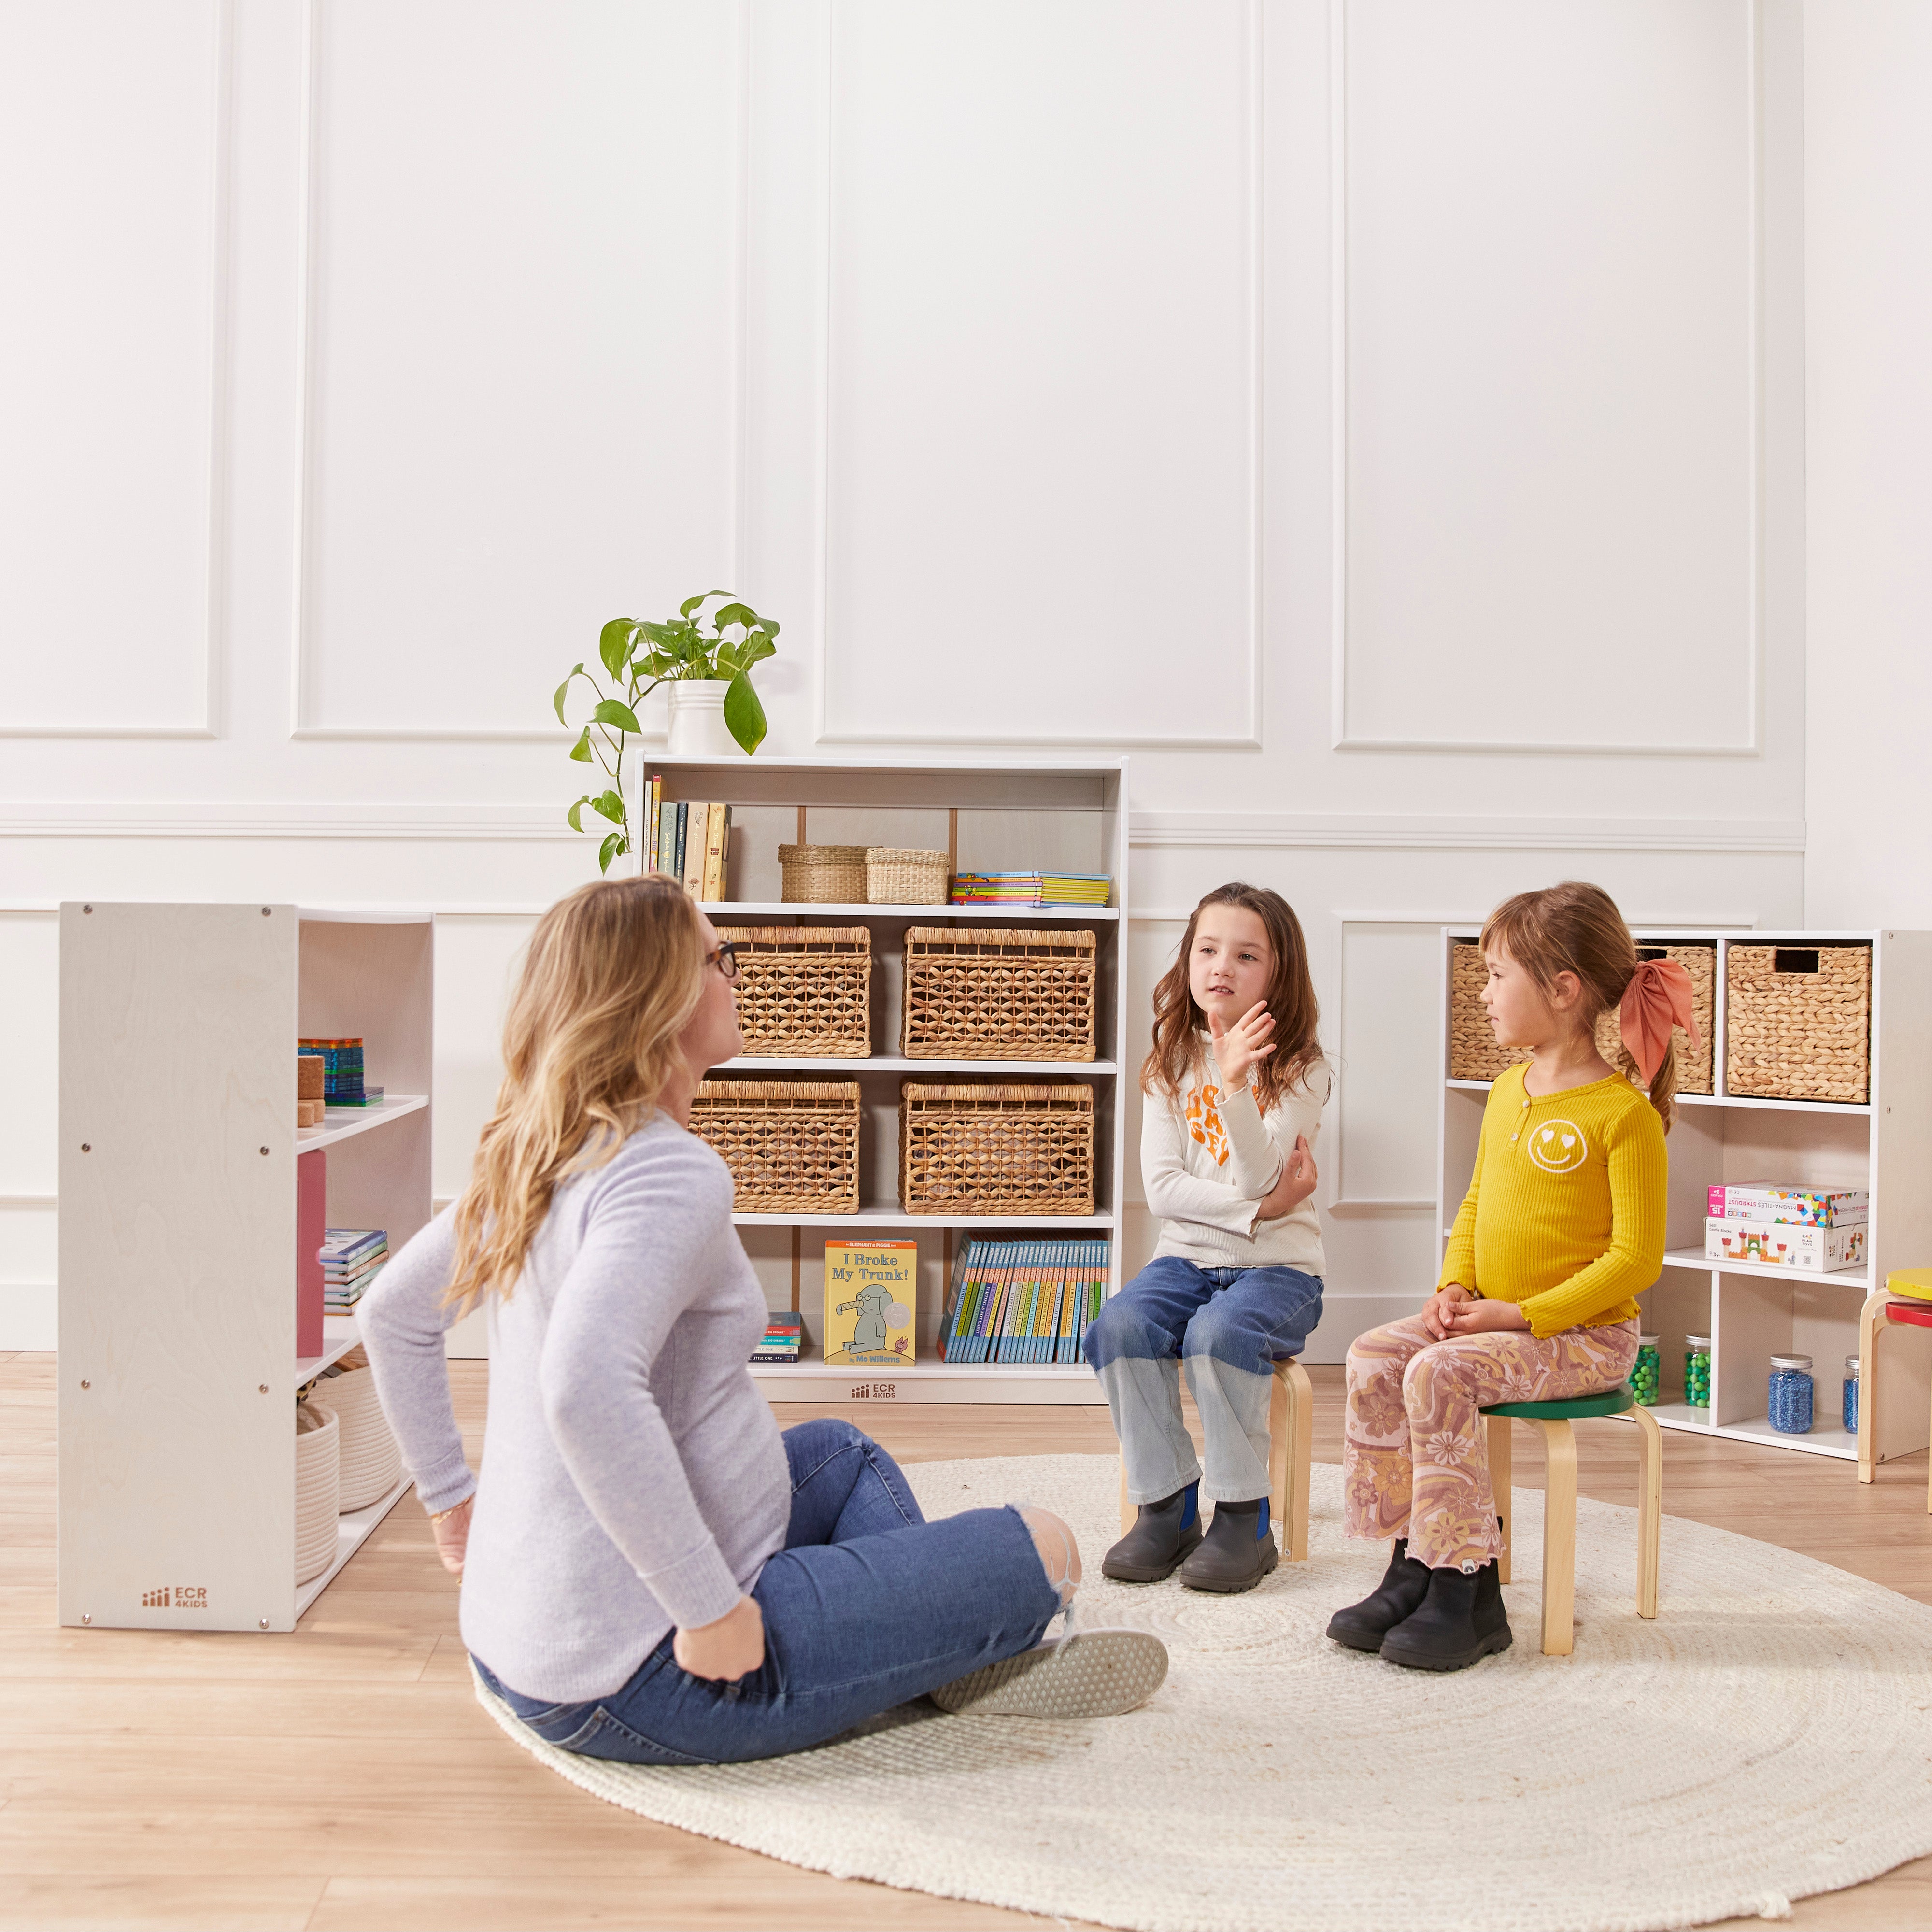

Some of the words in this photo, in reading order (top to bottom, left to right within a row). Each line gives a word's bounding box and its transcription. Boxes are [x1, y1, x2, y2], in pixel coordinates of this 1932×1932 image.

[843, 1253, 849, 1264] I
[854, 1254, 898, 1266] Broke
[832, 1268, 854, 1282] My
[859, 1268, 908, 1281] Trunk!
[176, 1587, 207, 1598] ECR
